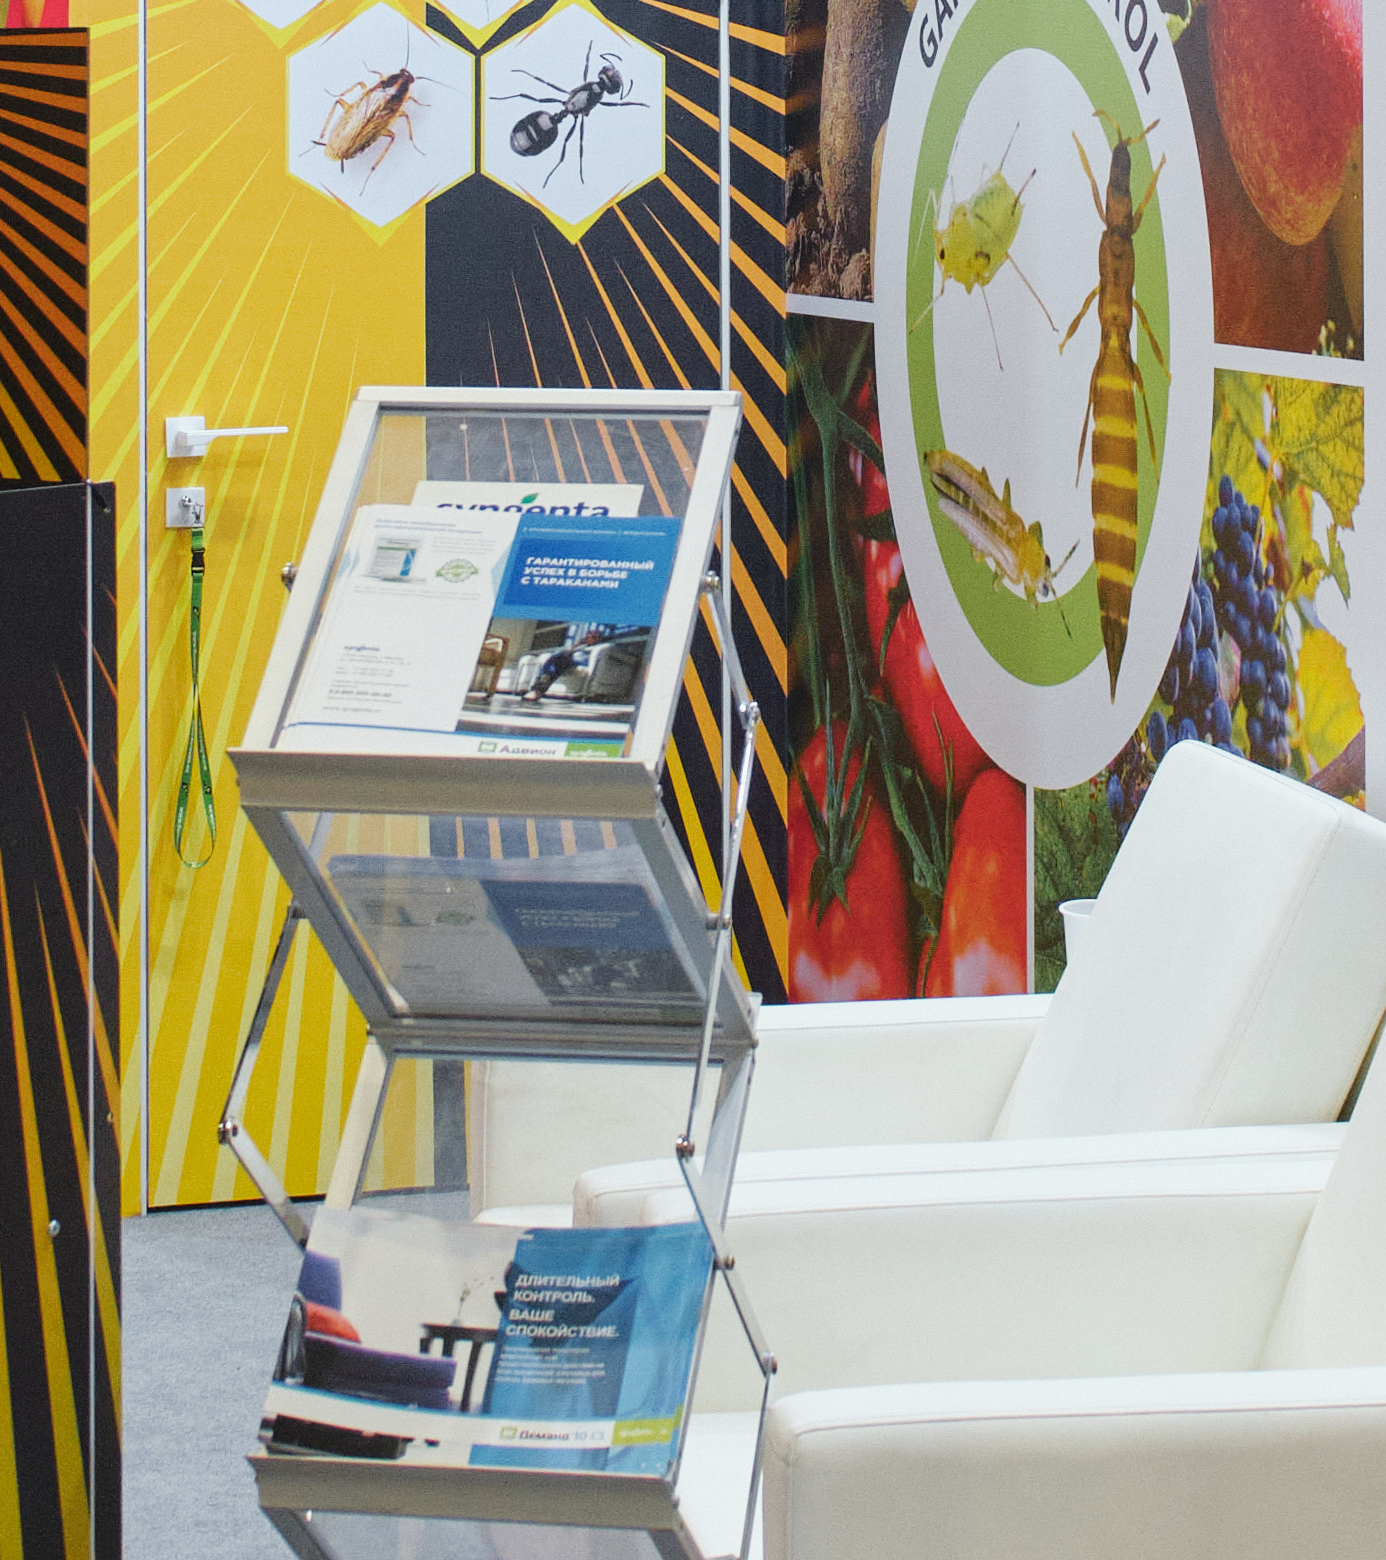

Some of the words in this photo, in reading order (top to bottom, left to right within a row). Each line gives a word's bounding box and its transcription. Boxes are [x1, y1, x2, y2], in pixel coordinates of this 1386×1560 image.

[525, 556, 655, 572] ГАРАНТИРОВАННЫЙ
[523, 565, 566, 578] УСПЕХ
[568, 568, 578, 578] В
[579, 568, 629, 580] БОРЬБЕ
[532, 577, 620, 589] ТАРАКАНАМИ
[515, 1273, 620, 1288] ДЛИТЕЛЬНЫЙ
[513, 1290, 595, 1303] КОНТРОЛЬ.
[509, 1309, 555, 1322] ВАШЕ
[506, 1323, 620, 1338] СПОКОЙСТВИЕ.
